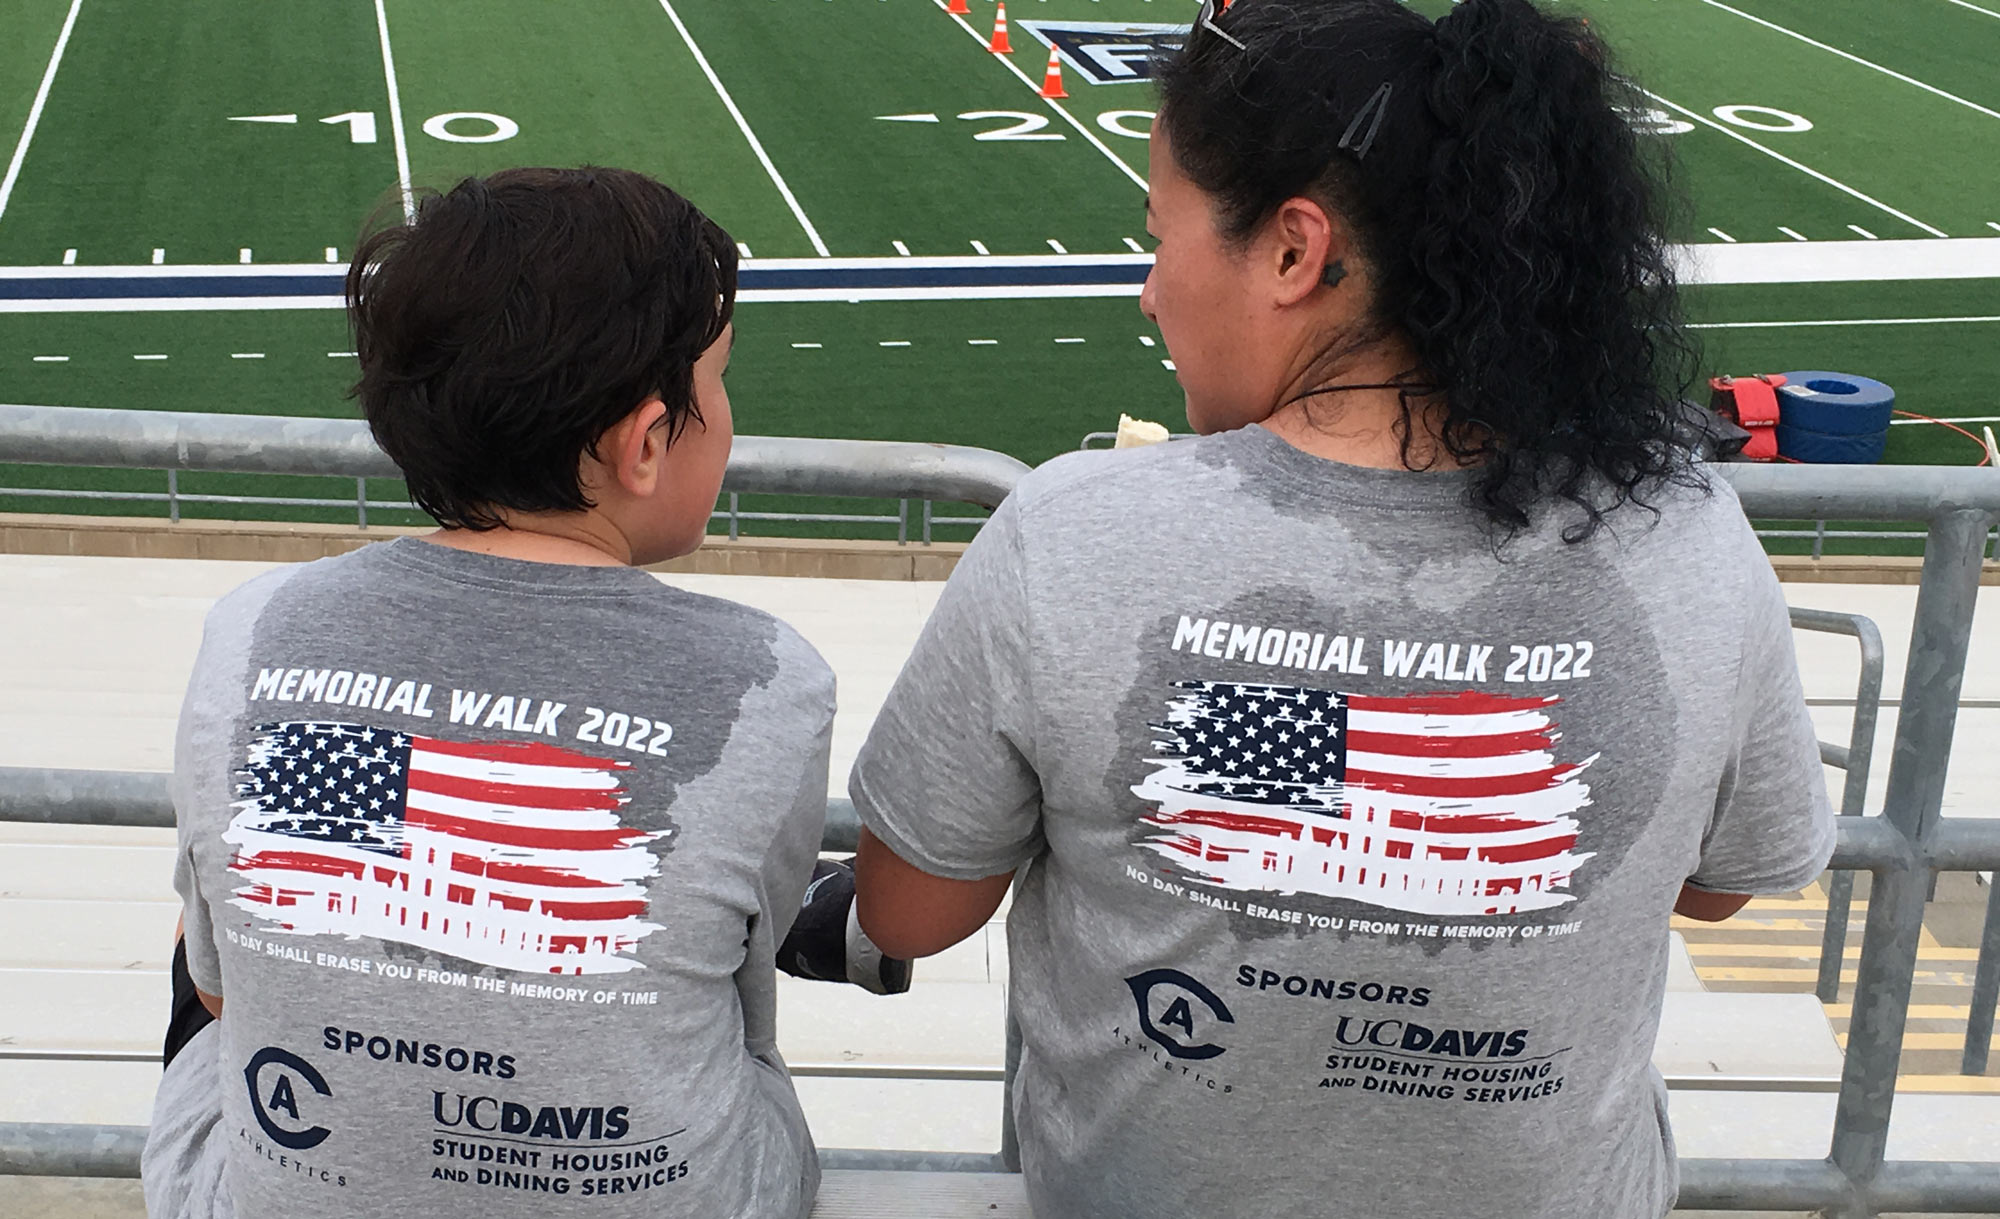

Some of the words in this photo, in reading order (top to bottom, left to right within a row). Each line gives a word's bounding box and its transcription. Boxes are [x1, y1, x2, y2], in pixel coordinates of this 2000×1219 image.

[1171, 615, 1370, 675] MEMORIAL
[1383, 638, 1494, 683] WALK
[1504, 640, 1594, 683] 2022
[250, 668, 434, 718] MEMORIAL
[449, 689, 567, 737] WALK
[575, 706, 674, 757] 2022
[1126, 864, 1149, 884] NO
[1152, 876, 1185, 898] DAY
[1189, 890, 1242, 914] SHALL
[1246, 903, 1302, 925] ERASE
[1306, 913, 1344, 931] YOU
[1348, 919, 1400, 936] FROM
[1404, 923, 1439, 938] THE
[1442, 925, 1517, 939] MEMORY
[1520, 925, 1544, 938] OF
[1546, 920, 1583, 937] TIME
[225, 927, 239, 945] NO
[240, 934, 263, 953] DAY
[266, 942, 312, 965] SHALL
[316, 952, 371, 975] ERASE
[375, 962, 412, 980] YOU
[416, 968, 467, 988] FROM
[472, 975, 506, 994] THE
[510, 982, 588, 1003] MEMORY
[593, 990, 617, 1005] OF
[621, 991, 659, 1006] TIME
[1235, 964, 1432, 1007] SPONSORS
[322, 1026, 517, 1080] SPONSORS
[1112, 1026, 1233, 1094] ATHLETICS
[1325, 1054, 1435, 1078] STUDENT
[1441, 1061, 1553, 1084] HOUSING
[1318, 1078, 1356, 1089] AND
[1361, 1075, 1455, 1100] DINING
[1462, 1076, 1565, 1104] SERVICES
[239, 1127, 348, 1187] ATHLETICS
[431, 1166, 470, 1183] AND
[476, 1167, 571, 1195] DINING
[581, 1160, 690, 1197] SERVICES
[432, 1138, 542, 1168] STUDENT
[551, 1144, 670, 1173] HOUSING
